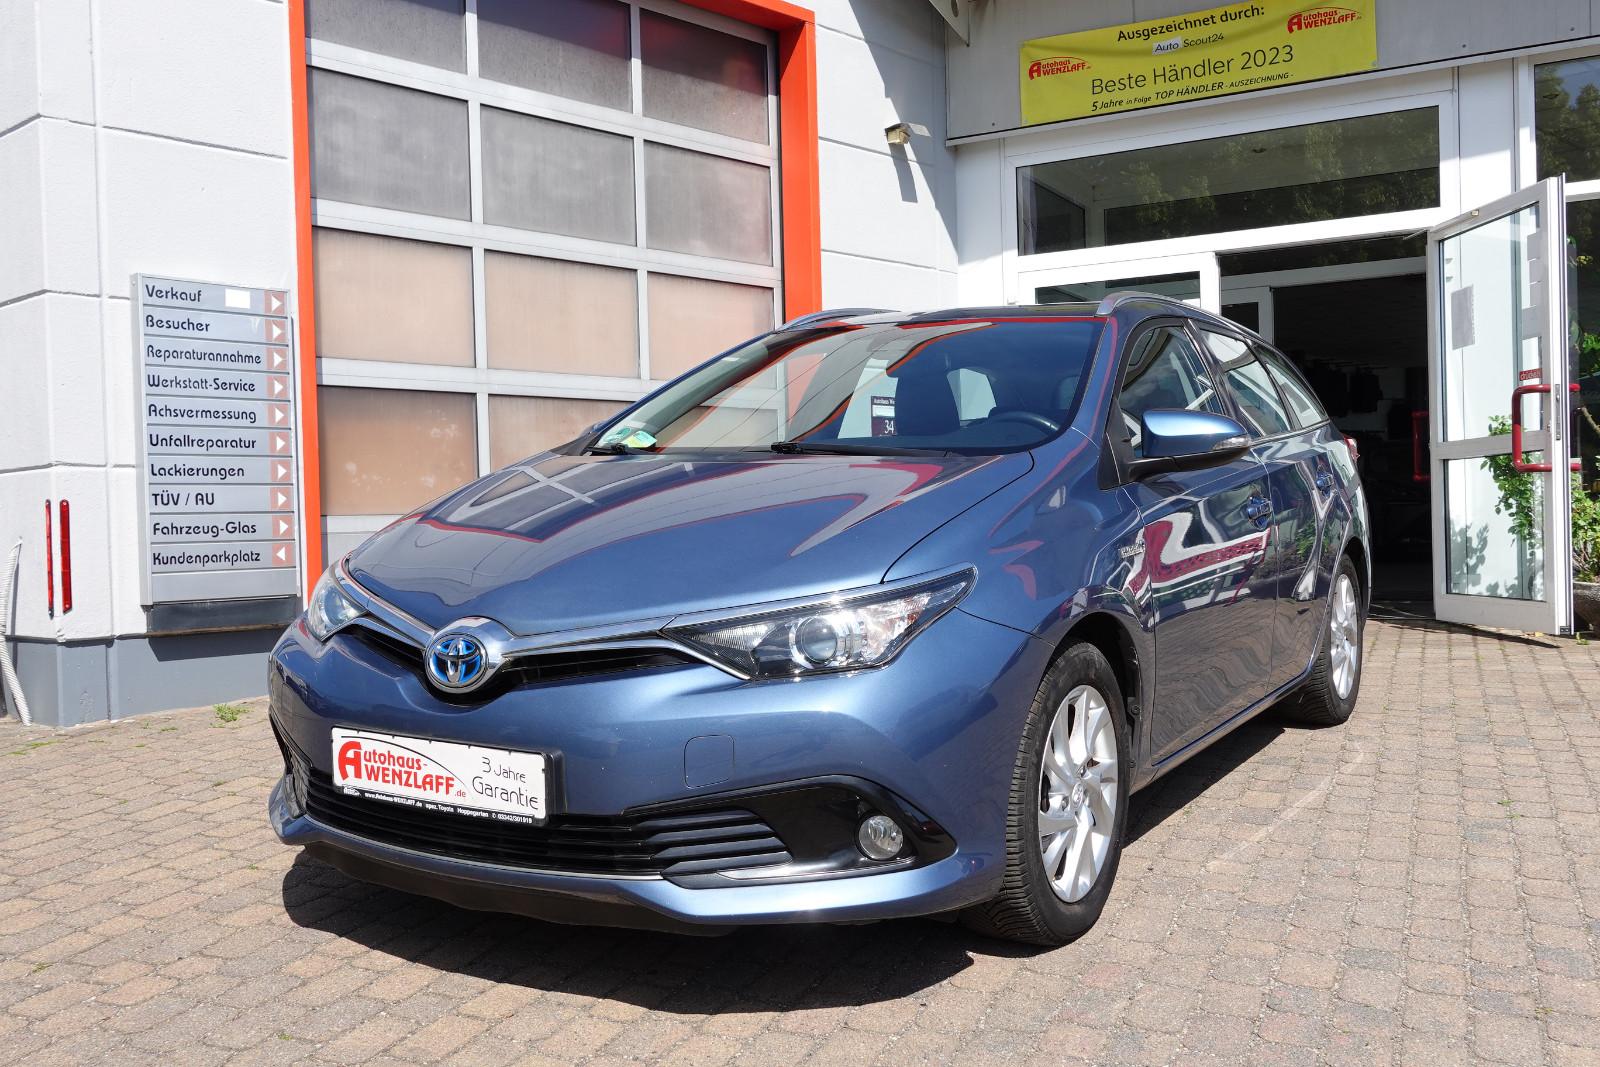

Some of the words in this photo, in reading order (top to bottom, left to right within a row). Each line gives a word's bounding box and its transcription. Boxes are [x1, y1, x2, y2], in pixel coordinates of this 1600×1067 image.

[1117, 14, 1217, 42] Ausgezeichnet
[1219, 5, 1266, 23] durch:
[1154, 41, 1180, 53] Auto
[1182, 32, 1225, 48] Scout24
[1091, 73, 1147, 95] Beste
[1153, 57, 1235, 86] Händler
[1240, 44, 1294, 71] 2023
[1091, 101, 1099, 112] 5
[1099, 98, 1124, 110] Jahre
[1133, 95, 1152, 104] Folge
[1155, 89, 1175, 100] TOP
[1176, 81, 1224, 97] HÄNDLER
[1228, 72, 1289, 89] AUSZEICHNUNG
[145, 284, 202, 303] Verkauf
[145, 314, 211, 332] Besucher
[147, 344, 262, 365] Reparaturannahme
[147, 374, 256, 392] Werkstatt-Service
[148, 403, 257, 424] Achsvermessung
[149, 433, 257, 451] Unfallreparatur
[150, 463, 245, 480] Lackierungen
[151, 489, 180, 506] TÜV
[195, 492, 215, 506] AU
[152, 521, 257, 538] Fahrzeug-Glas
[152, 550, 261, 567] Kundenparkplatz
[481, 756, 492, 774] 3
[493, 764, 527, 784] Jahre
[472, 775, 539, 811] Garantie
[457, 807, 489, 818] Hoppegarten
